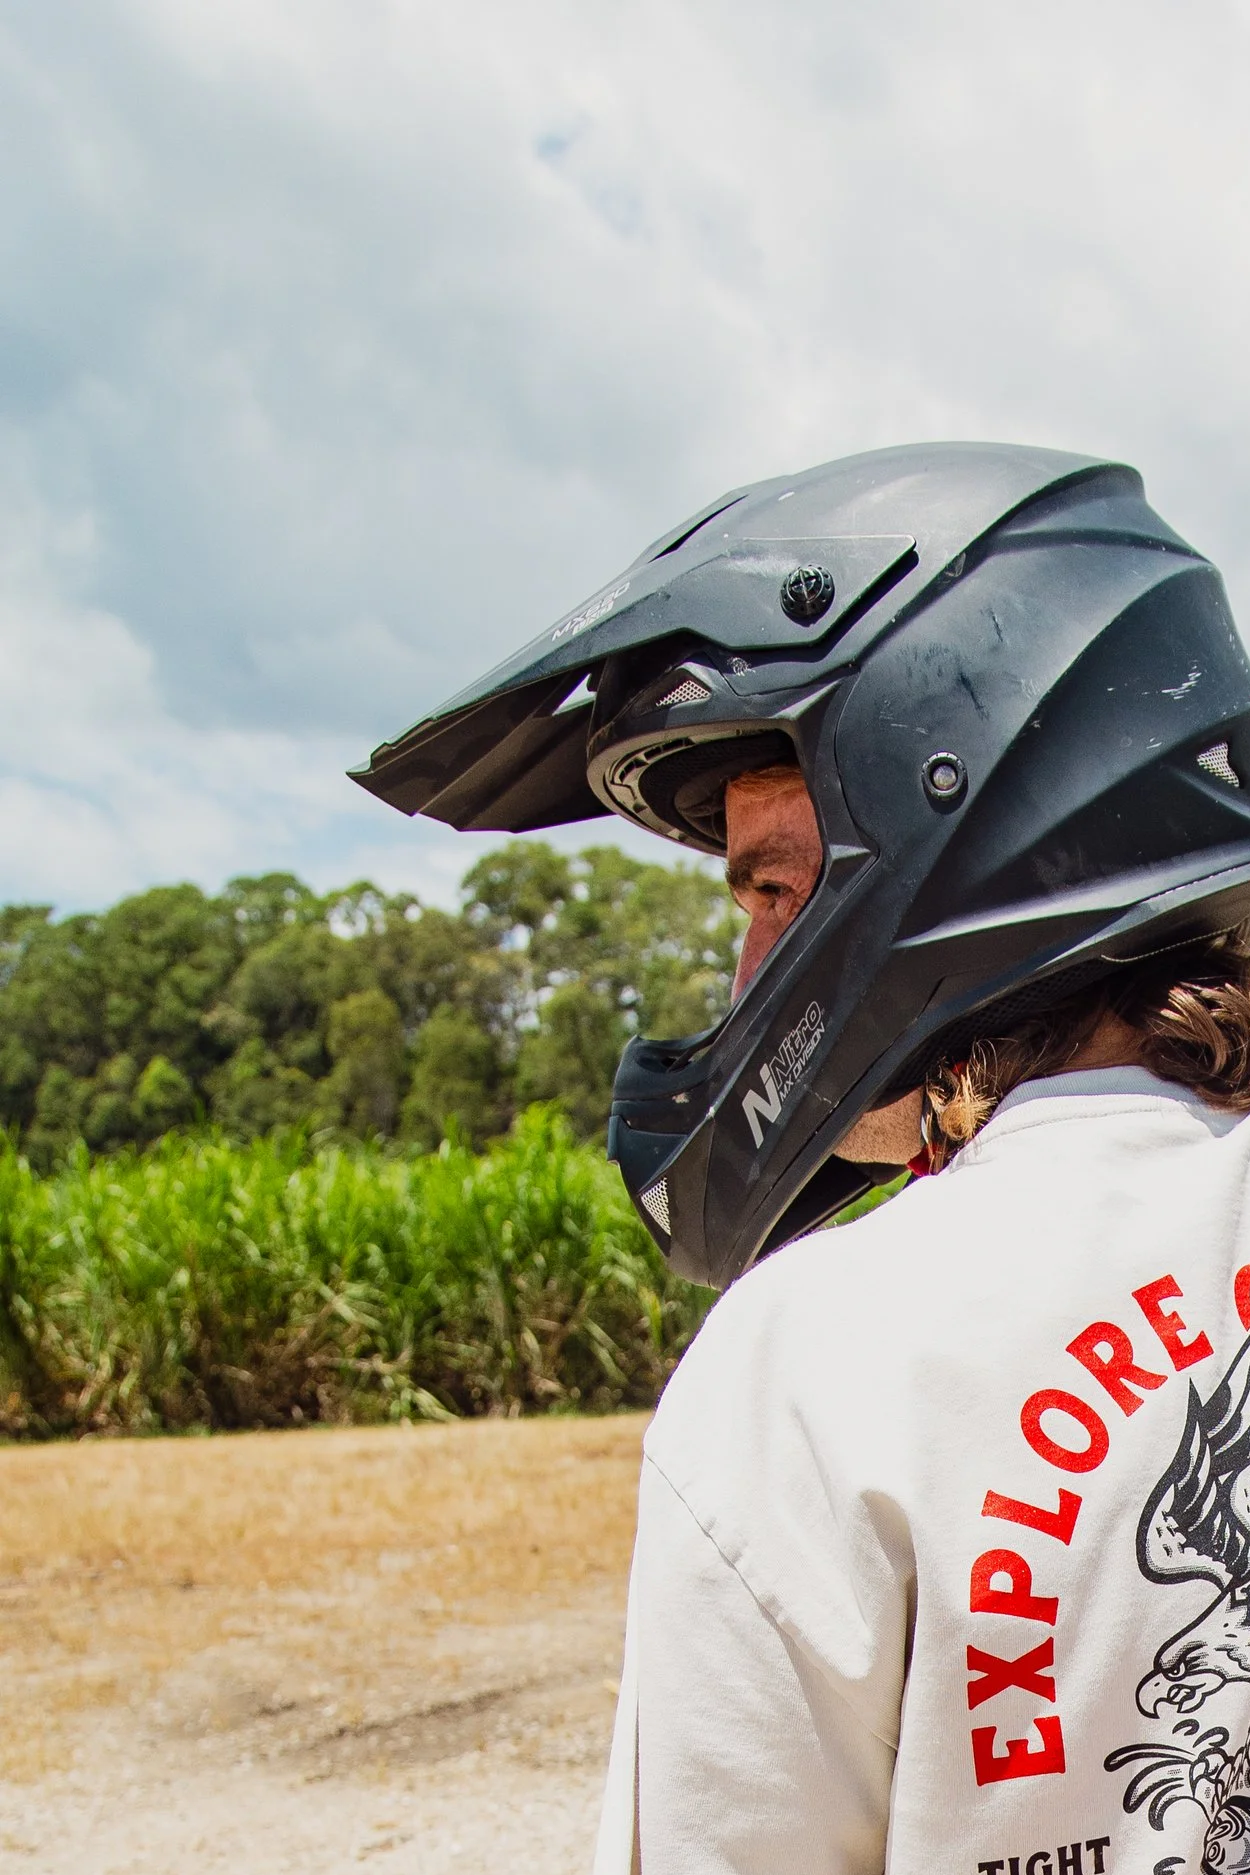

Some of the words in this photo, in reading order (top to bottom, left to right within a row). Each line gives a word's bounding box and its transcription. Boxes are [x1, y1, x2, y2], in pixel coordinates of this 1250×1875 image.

[779, 1077, 795, 1102] MX
[793, 1021, 826, 1079] DIVISION
[967, 1275, 1214, 1784] EXPLORE
